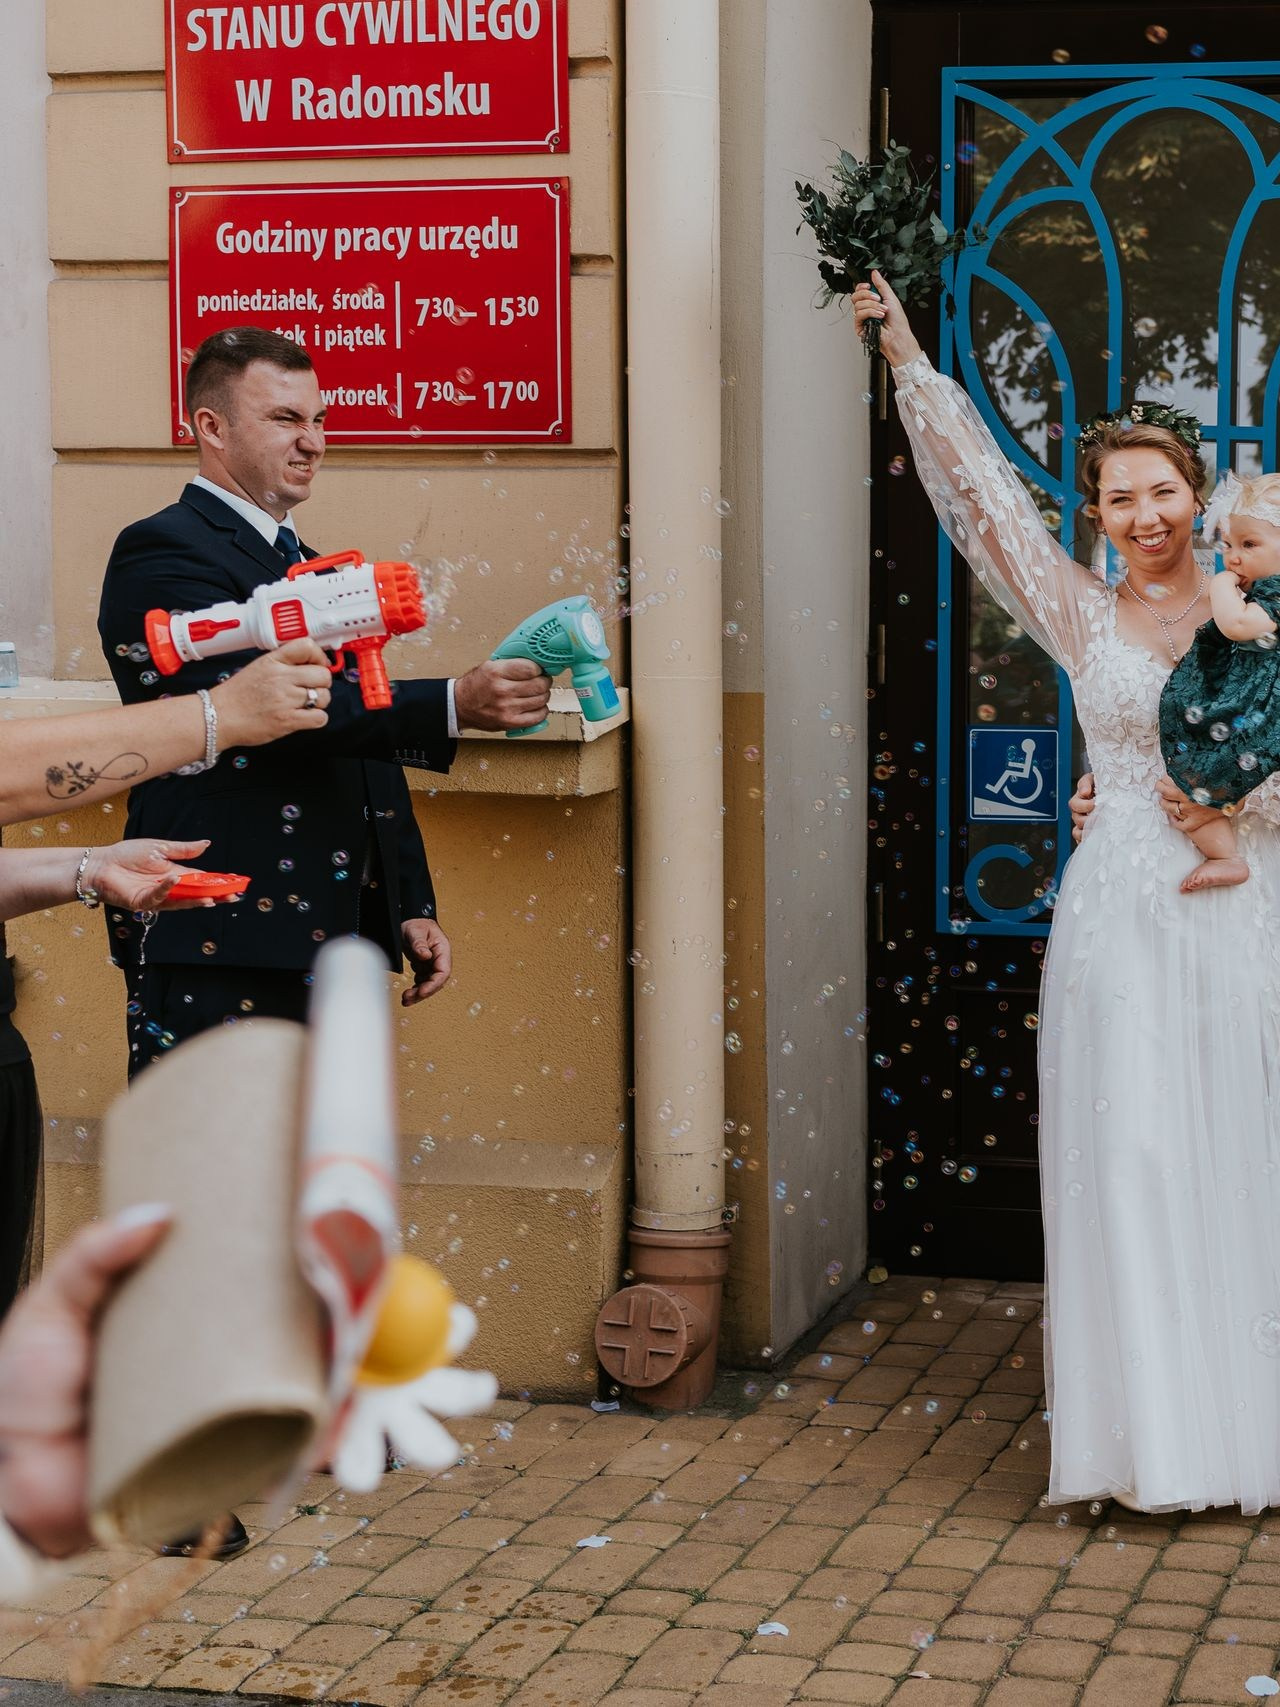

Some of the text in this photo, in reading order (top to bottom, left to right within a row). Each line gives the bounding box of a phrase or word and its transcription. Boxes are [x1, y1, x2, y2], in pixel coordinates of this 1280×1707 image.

[187, 0, 541, 51] STANU CYWILNEGO
[235, 71, 490, 122] W Radomsku
[216, 215, 518, 261] Godziny pracy urzędu
[197, 287, 385, 318] poniedziałek, środa
[314, 323, 321, 346] i
[325, 322, 387, 352] piątek
[320, 383, 388, 407] wtorek
